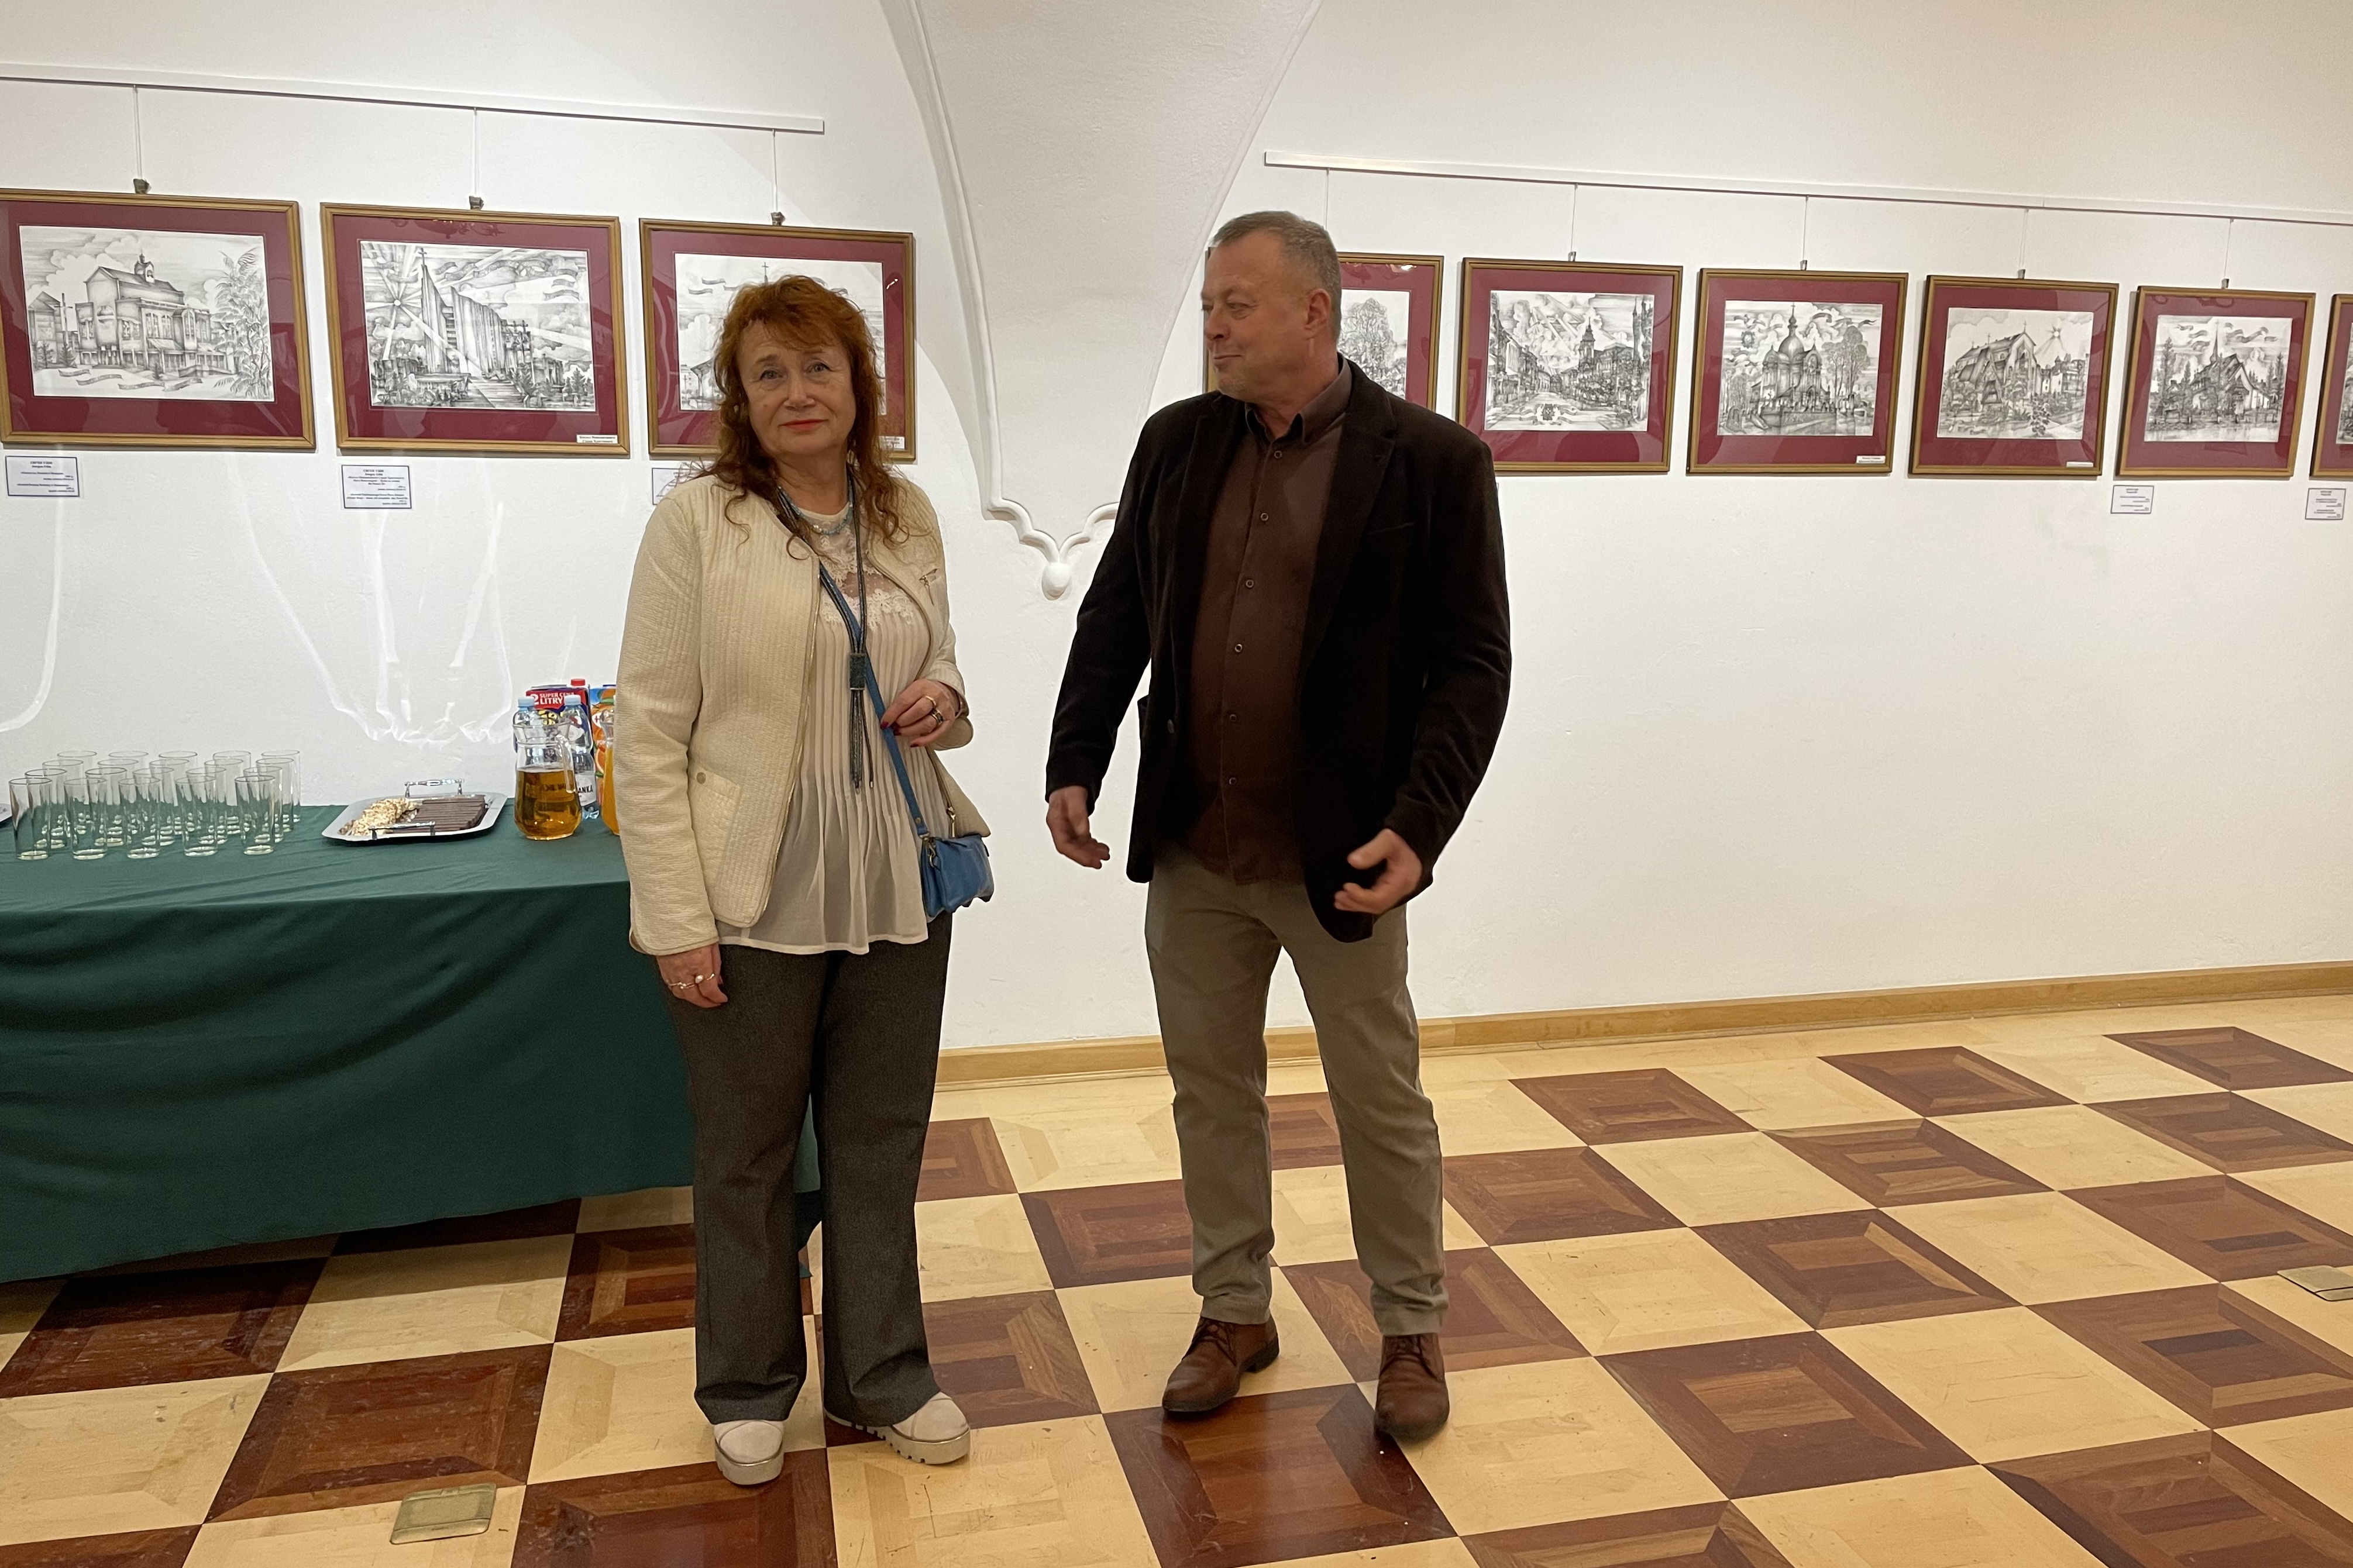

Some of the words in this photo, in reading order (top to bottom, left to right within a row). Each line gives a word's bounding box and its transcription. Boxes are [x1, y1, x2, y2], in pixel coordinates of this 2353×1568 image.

[529, 694, 539, 705] 2
[540, 697, 563, 705] LITRY
[579, 784, 594, 794] ANKA
